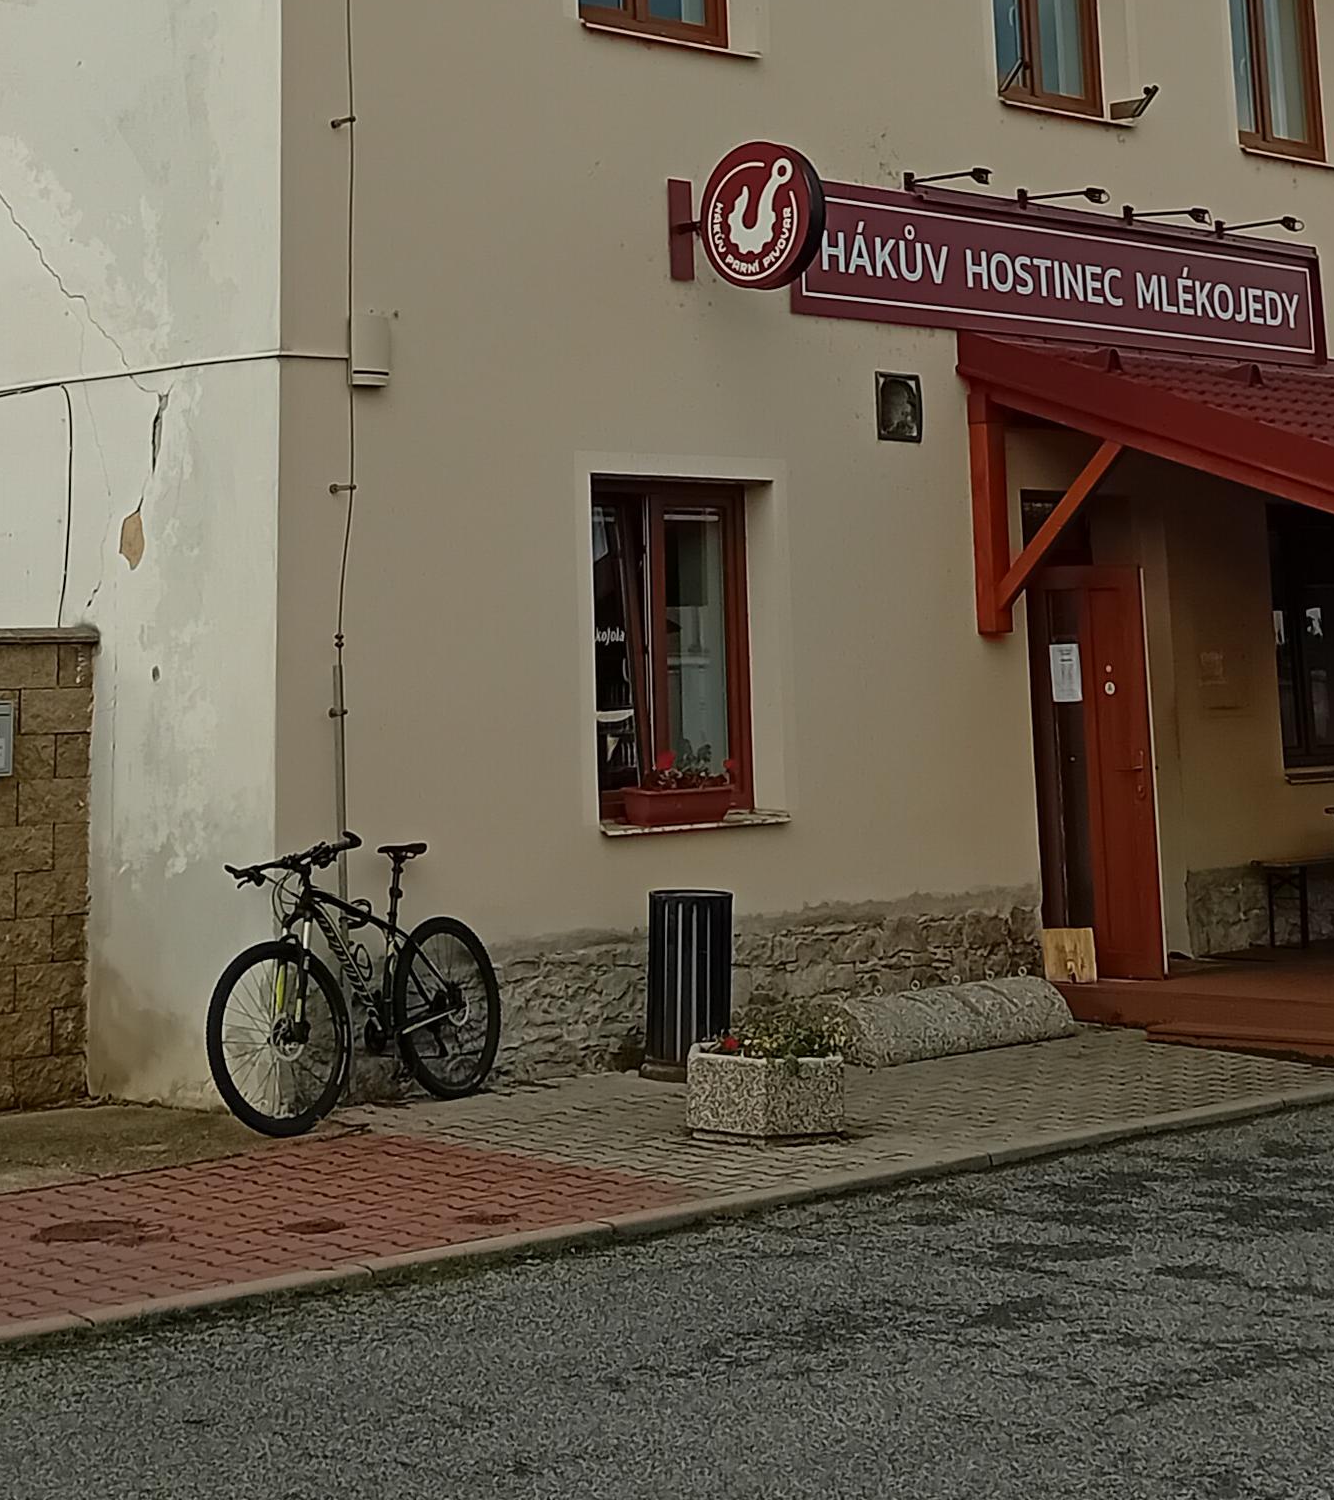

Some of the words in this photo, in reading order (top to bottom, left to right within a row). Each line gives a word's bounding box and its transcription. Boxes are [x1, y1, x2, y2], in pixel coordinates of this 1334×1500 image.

[725, 254, 760, 274] PARNÍ
[763, 206, 793, 269] PIVOVAR
[821, 221, 949, 284] HÁKŮV
[965, 248, 1123, 307] HOSTINEC
[1135, 266, 1299, 329] MLÉKOJEDY
